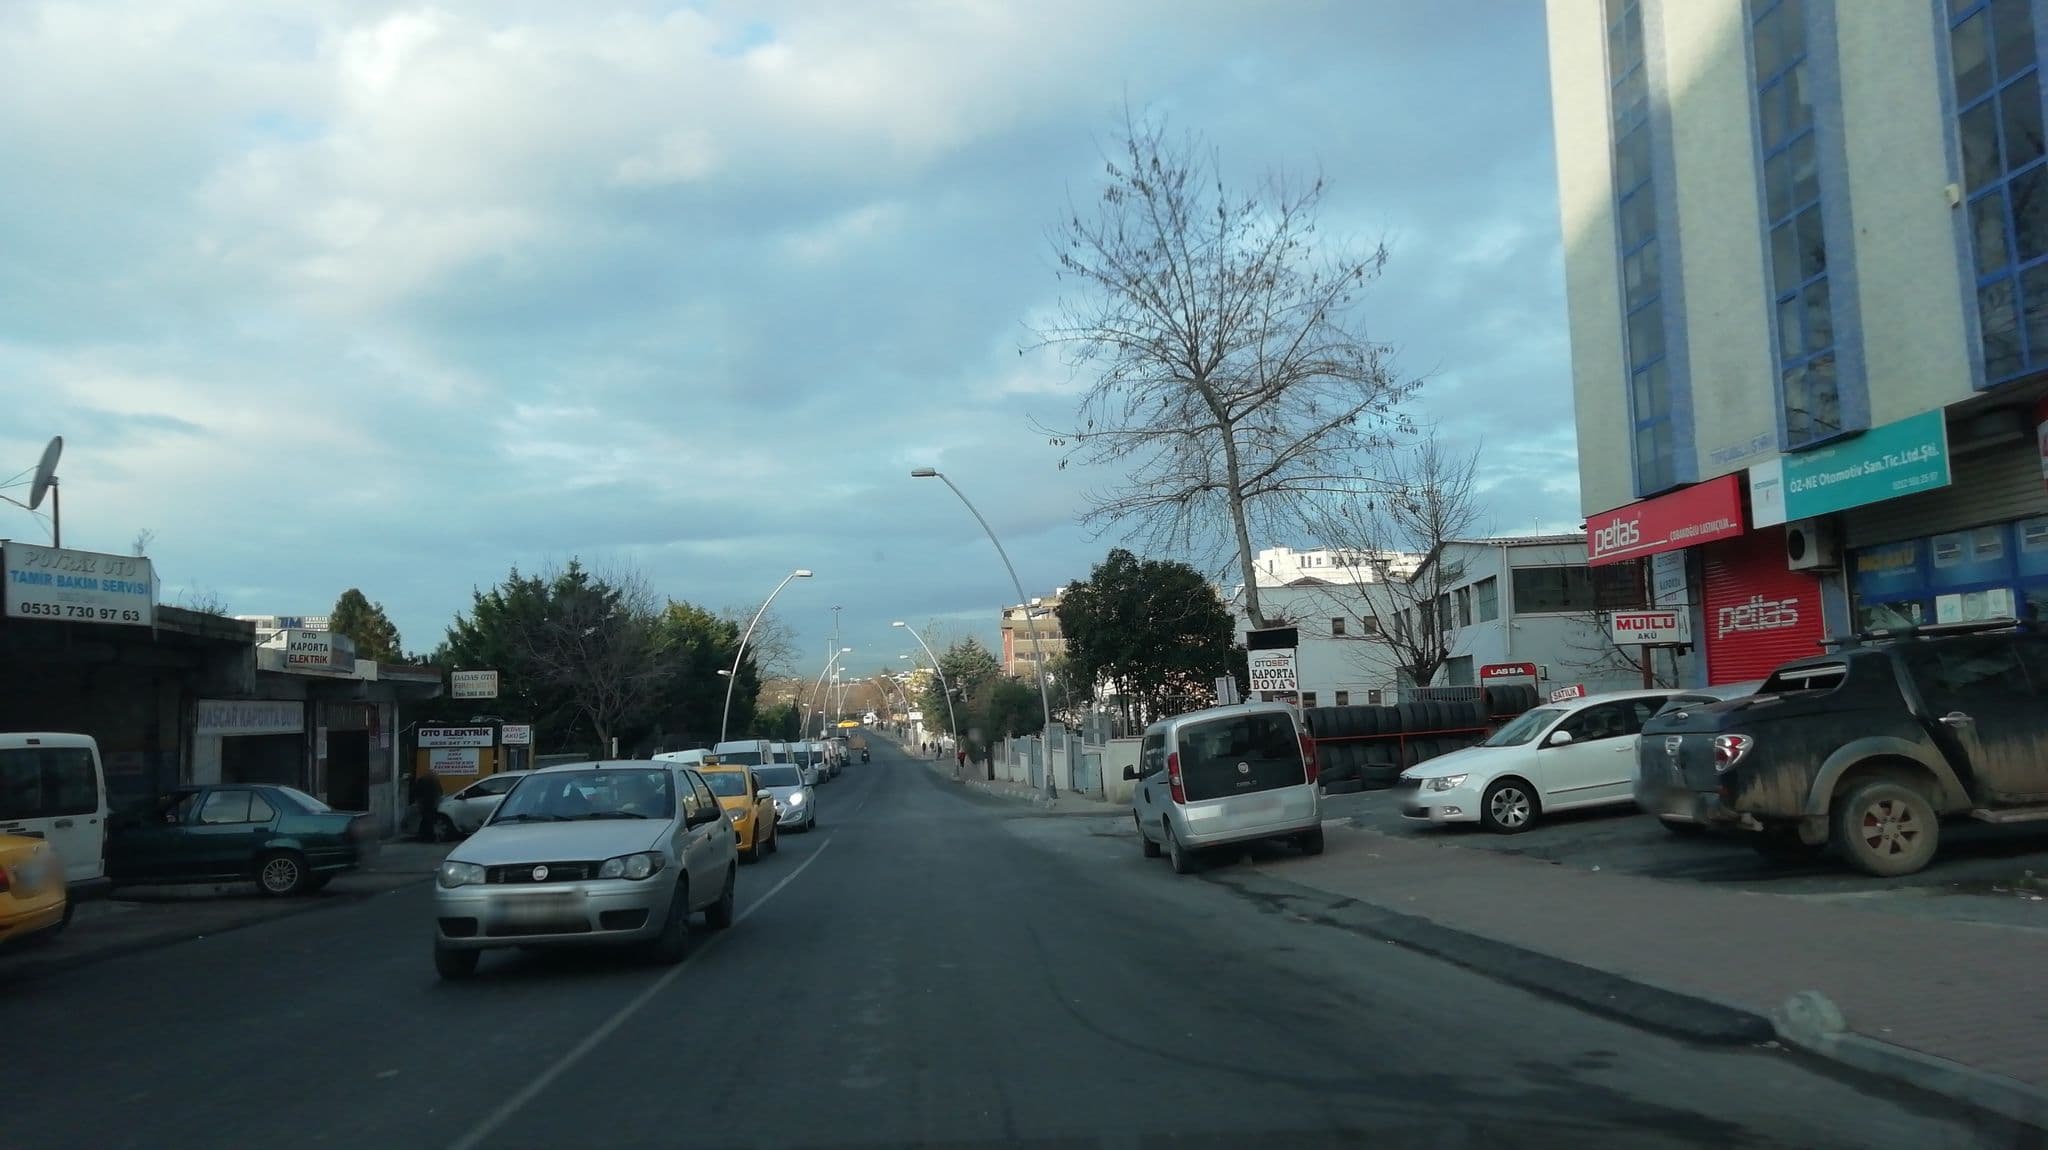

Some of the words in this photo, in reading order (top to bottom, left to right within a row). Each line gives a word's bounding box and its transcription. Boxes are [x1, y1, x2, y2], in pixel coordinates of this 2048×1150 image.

[1819, 465, 1862, 486] Otomotiv
[1595, 518, 1639, 558] petlas
[57, 575, 98, 590] BAKIM
[21, 602, 61, 616] 0533
[67, 605, 94, 619] 730
[100, 608, 117, 620] 97
[122, 610, 140, 622] 63
[1616, 614, 1675, 630] MUTLU
[302, 632, 317, 640] OTO
[291, 642, 328, 652] KAPORTA
[1254, 659, 1289, 668] OTOSER
[1252, 669, 1295, 679] KAPORTA
[1491, 667, 1525, 676] LASSA
[1253, 680, 1286, 690] BOYA
